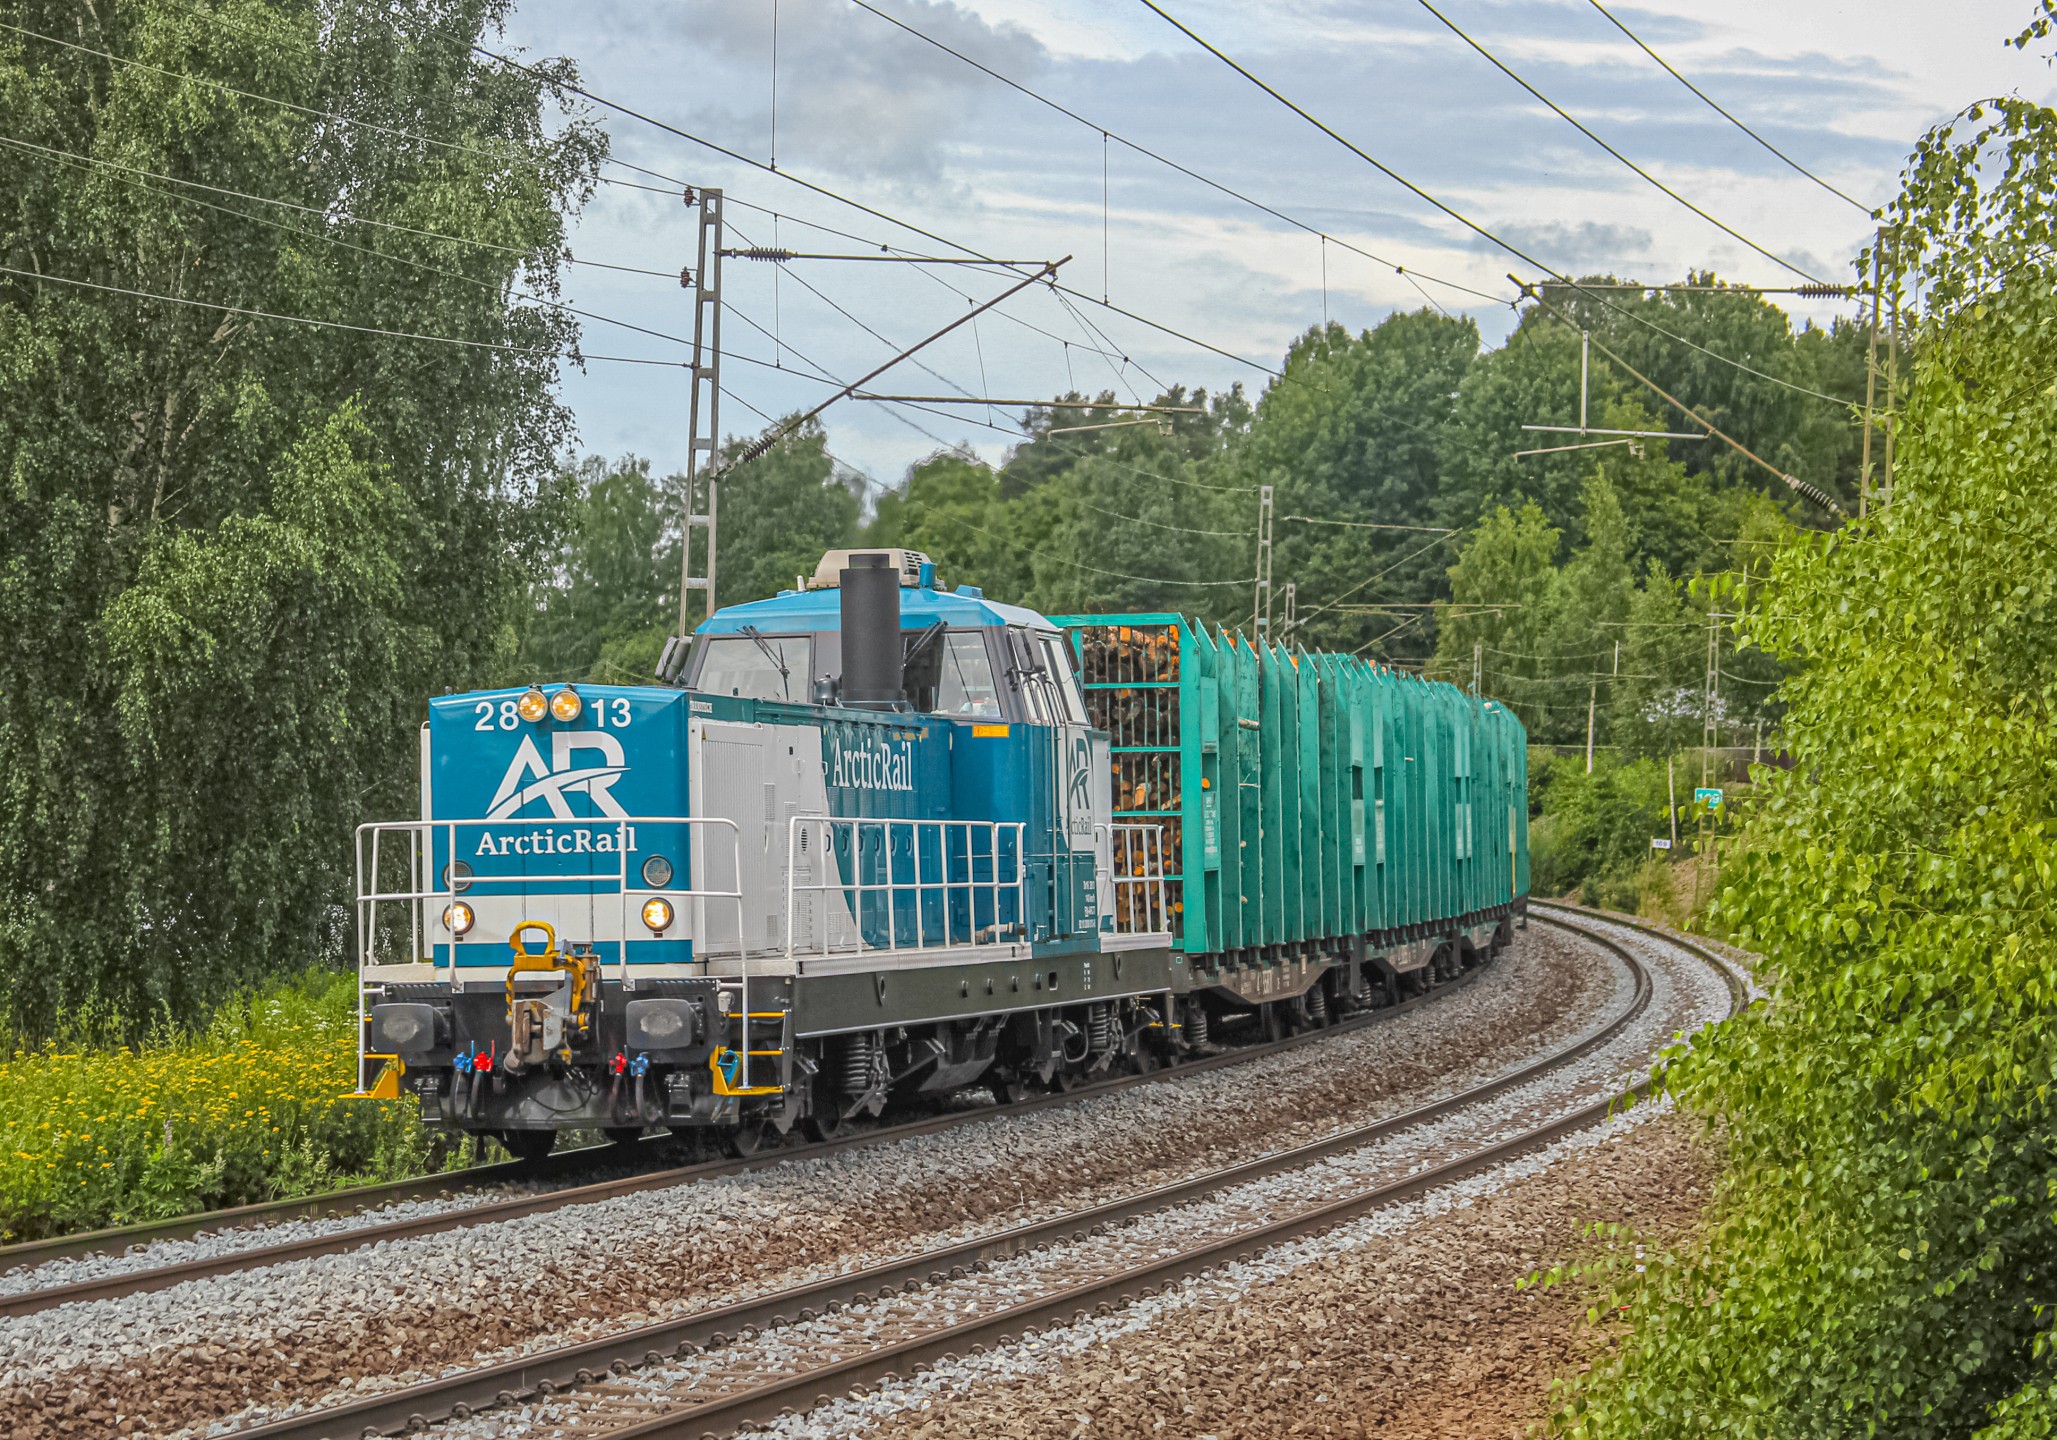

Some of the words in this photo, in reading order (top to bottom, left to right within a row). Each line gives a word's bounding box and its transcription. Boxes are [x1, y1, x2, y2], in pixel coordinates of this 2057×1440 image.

[474, 701, 519, 731] 28
[590, 697, 632, 728] 13
[832, 738, 913, 791] ArcticRail
[475, 826, 638, 856] ArcticRail
